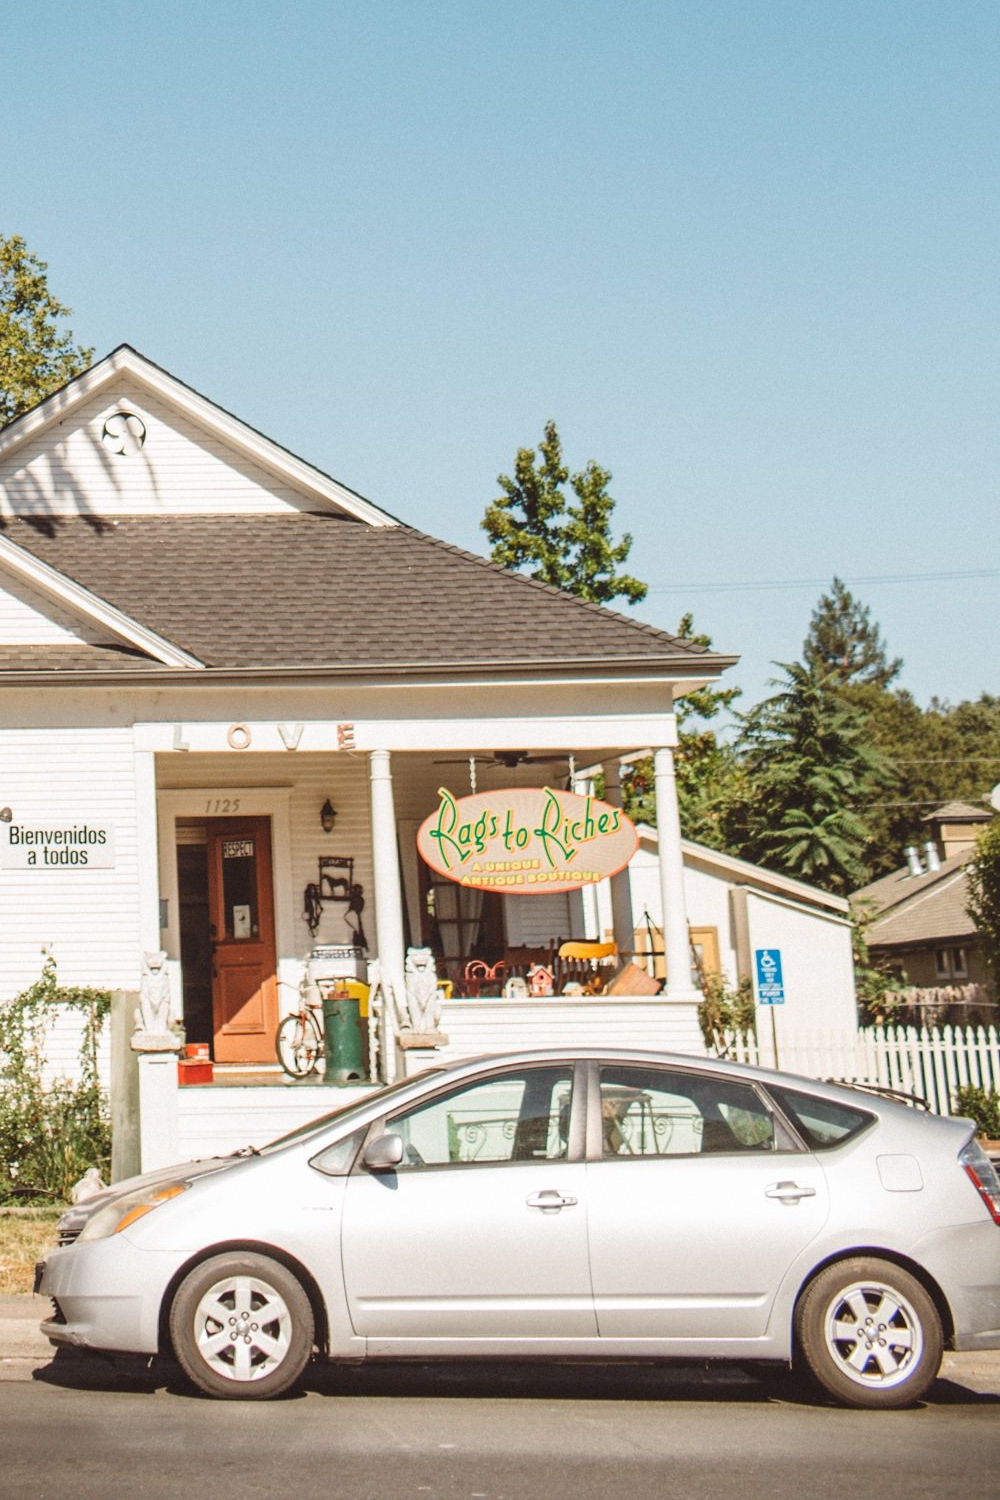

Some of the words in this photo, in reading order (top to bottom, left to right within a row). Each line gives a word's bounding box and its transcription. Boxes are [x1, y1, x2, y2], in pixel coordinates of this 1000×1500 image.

[205, 799, 241, 813] 1125
[9, 825, 107, 845] Bienvenidos
[428, 788, 498, 870] Rags
[502, 809, 529, 852] to
[533, 787, 622, 869] Riches
[27, 850, 37, 865] a
[43, 846, 88, 865] todos
[471, 862, 483, 873] A
[486, 860, 541, 873] UNIQUE
[461, 875, 525, 886] ANTIQUE
[528, 872, 601, 884] BOUTIQUE
